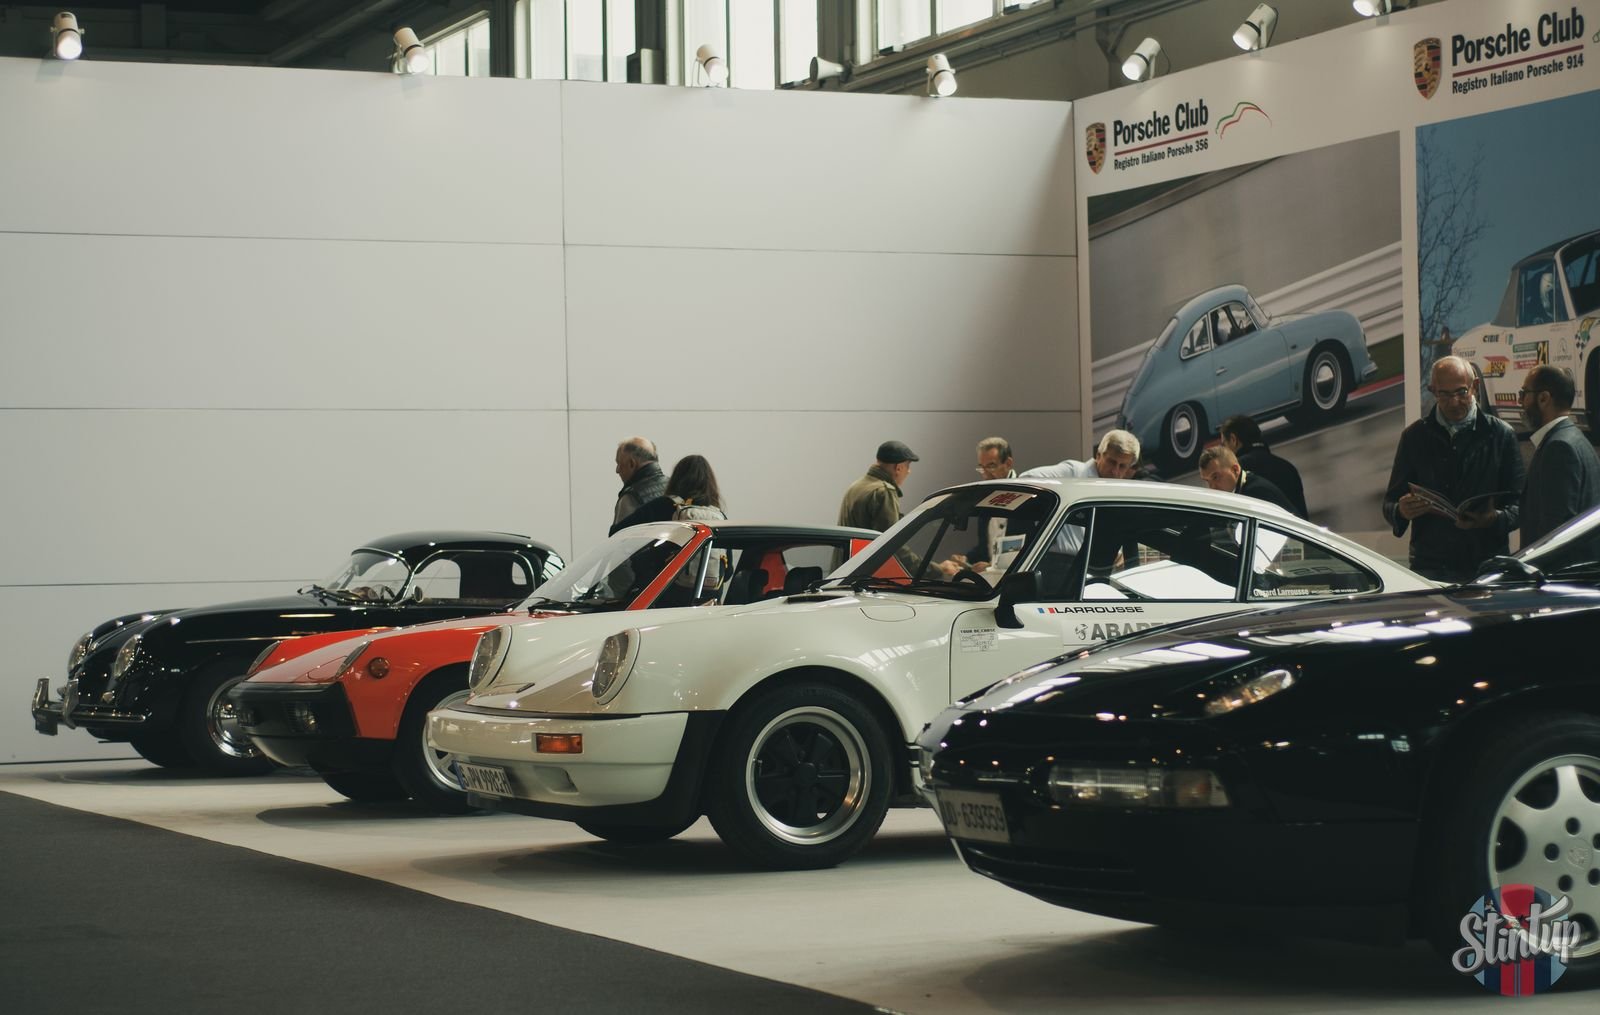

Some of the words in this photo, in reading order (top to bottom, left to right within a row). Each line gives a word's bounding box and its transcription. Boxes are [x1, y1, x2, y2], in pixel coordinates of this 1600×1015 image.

[1452, 23, 1531, 66] Porsche
[1537, 7, 1584, 47] Club
[1452, 77, 1488, 95] Registro
[1490, 70, 1524, 86] Italiano
[1526, 61, 1564, 79] Porsche
[1566, 53, 1585, 69] 914
[1114, 111, 1170, 146] Porsche
[1175, 99, 1209, 132] Club
[1113, 155, 1140, 171] Registro
[1141, 149, 1166, 164] Italiano
[1167, 143, 1194, 158] Porsche
[1195, 138, 1209, 152] 356
[1538, 341, 1549, 367] 21
[1055, 606, 1144, 614] LARROUSSE
[1091, 623, 1163, 640] ABA
